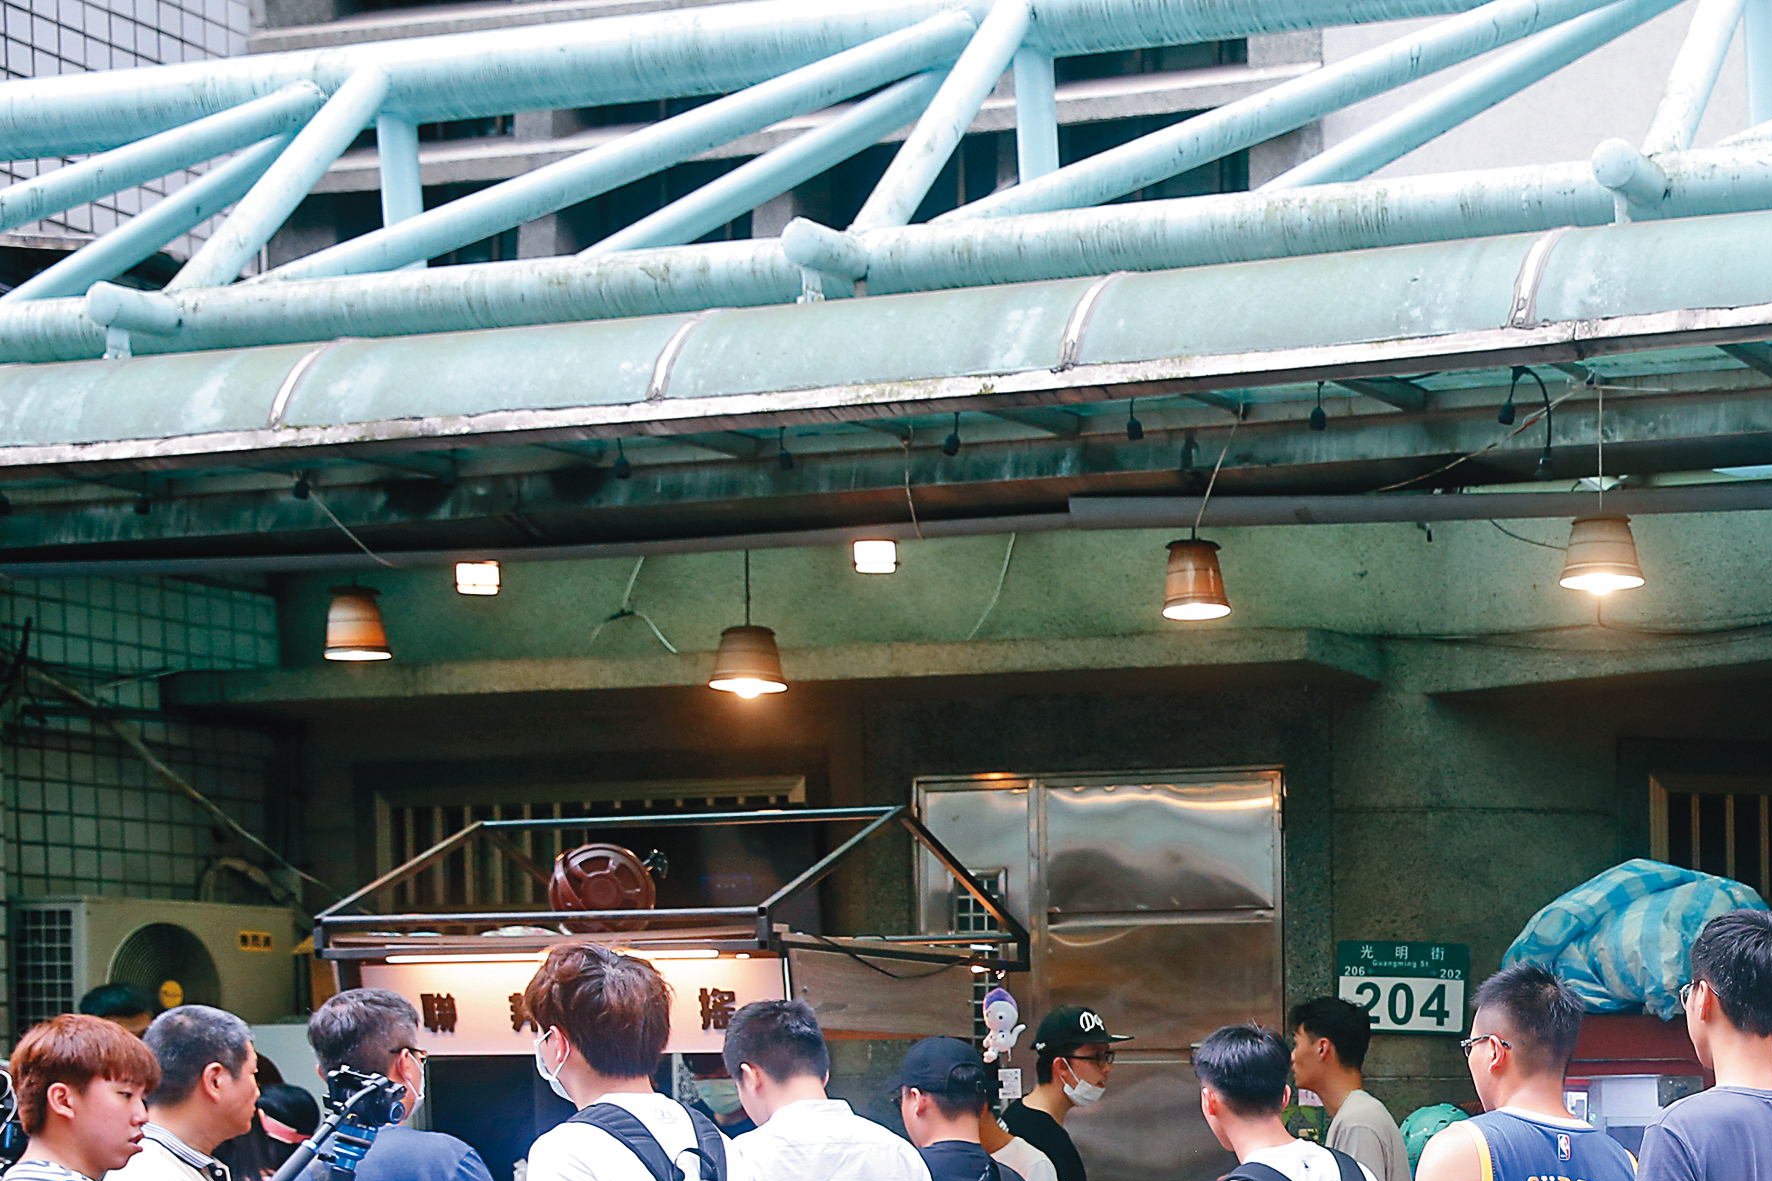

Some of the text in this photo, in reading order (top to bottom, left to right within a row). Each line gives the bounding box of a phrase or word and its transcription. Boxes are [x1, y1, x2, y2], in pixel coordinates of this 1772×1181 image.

[1360, 944, 1445, 961] 光明街
[1372, 959, 1417, 969] Guangming
[1344, 965, 1366, 977] 206
[1440, 968, 1462, 980] 202
[1355, 981, 1450, 1027] 204
